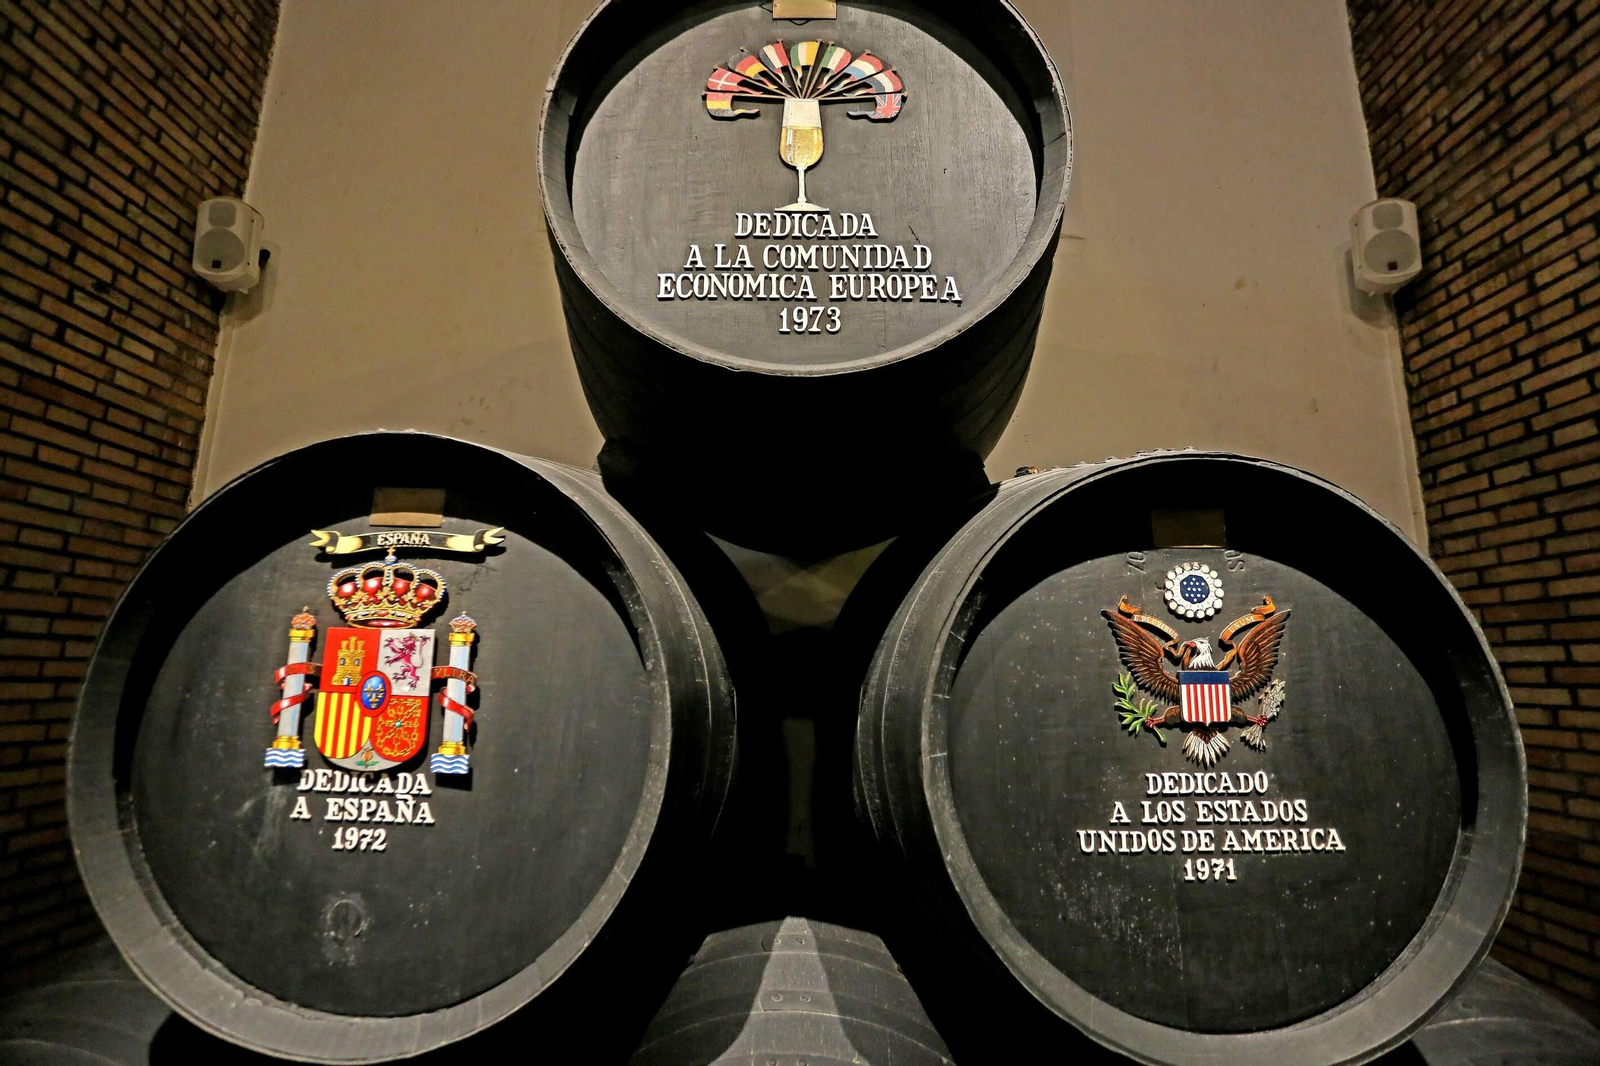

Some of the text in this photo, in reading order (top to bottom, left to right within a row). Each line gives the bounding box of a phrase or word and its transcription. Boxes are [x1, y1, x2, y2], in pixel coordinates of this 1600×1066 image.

[735, 212, 879, 238] DEDICADA
[683, 243, 932, 270] A LA COMUNIDAD
[657, 273, 963, 302] ECONOMICA EUROPEA
[779, 306, 842, 333] 1973
[297, 768, 432, 796] DEDICADA
[1145, 770, 1269, 796] DEDICADO
[289, 794, 435, 824] A ESPAÑA
[1109, 799, 1308, 824] A LOS ESTADOS
[331, 826, 388, 851] 1972
[1076, 828, 1347, 853] UNIDOS DE AMERICA
[1184, 857, 1238, 882] 1971
